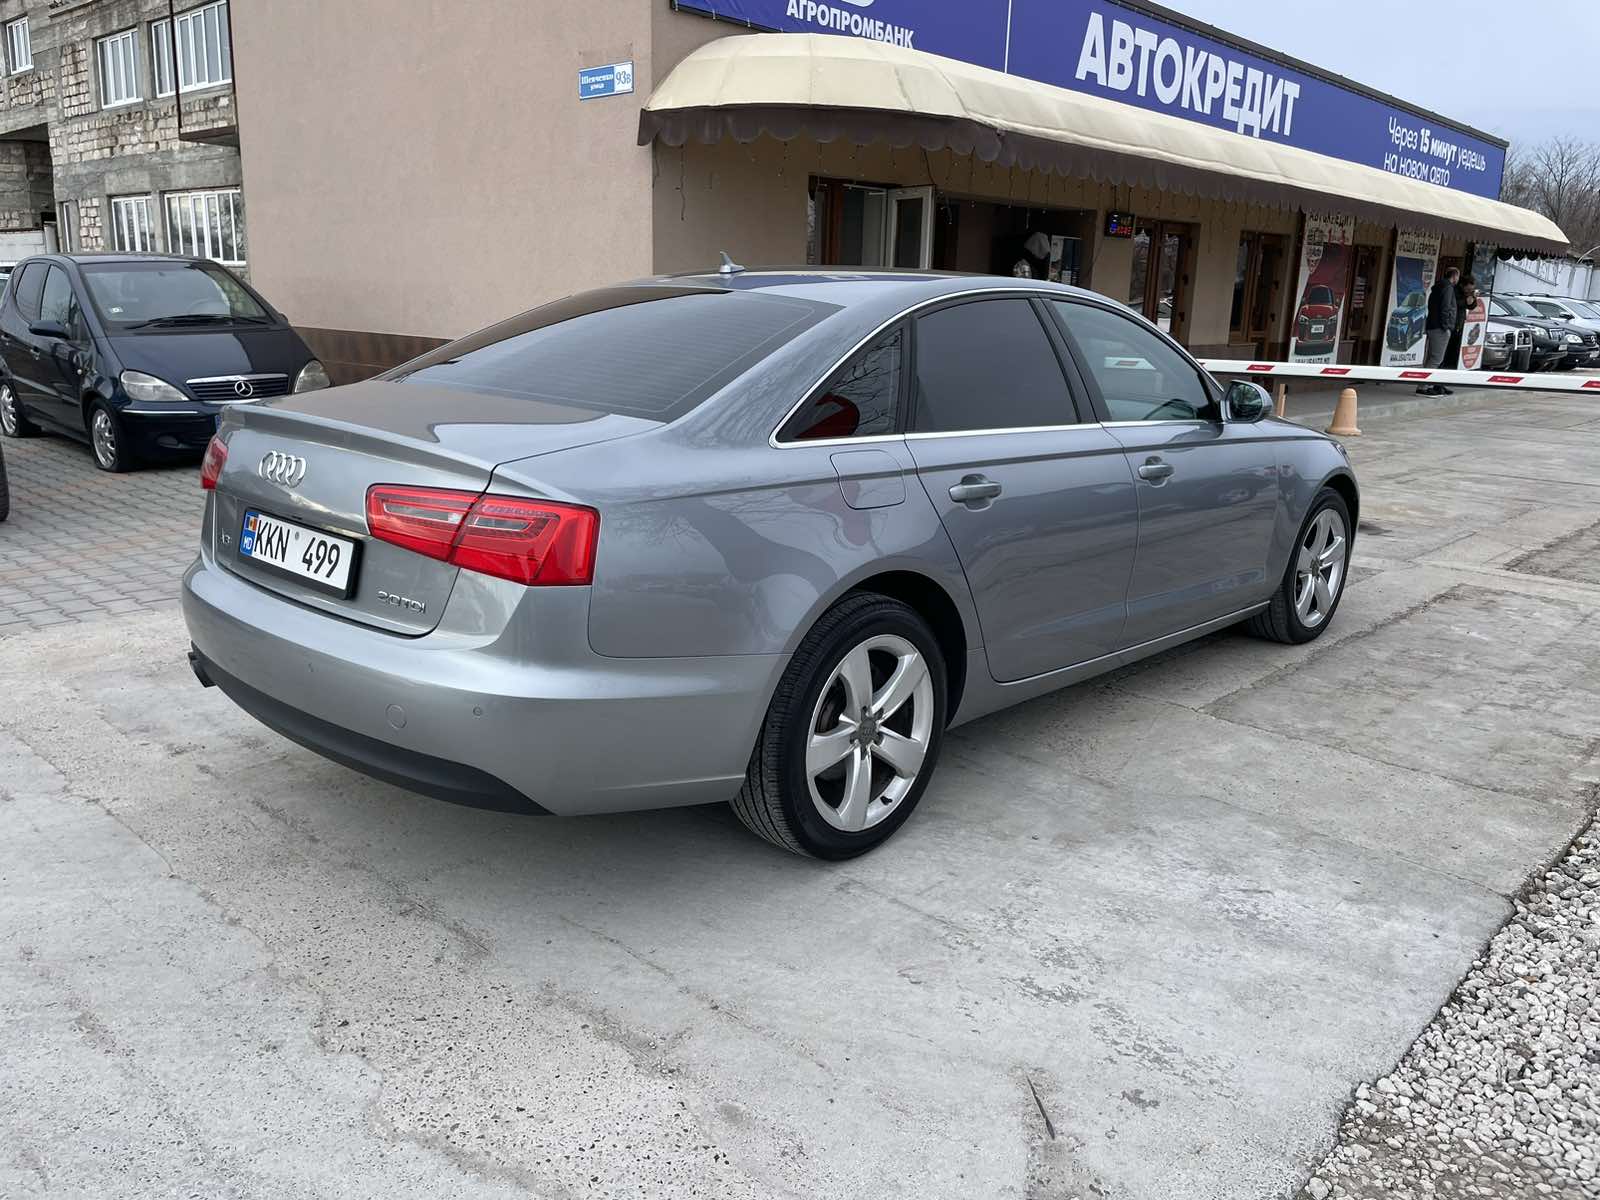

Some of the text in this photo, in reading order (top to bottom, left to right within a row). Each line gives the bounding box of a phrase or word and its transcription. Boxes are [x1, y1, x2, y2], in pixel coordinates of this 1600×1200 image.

[786, 0, 915, 49] АГРОПРОМБАНК
[1075, 12, 1300, 138] АВТОКРЕДИТ
[1388, 116, 1486, 172] Через 15 минут уедешь
[1400, 156, 1429, 180] новом
[243, 536, 253, 550] MD
[254, 519, 341, 578] KKN 499
